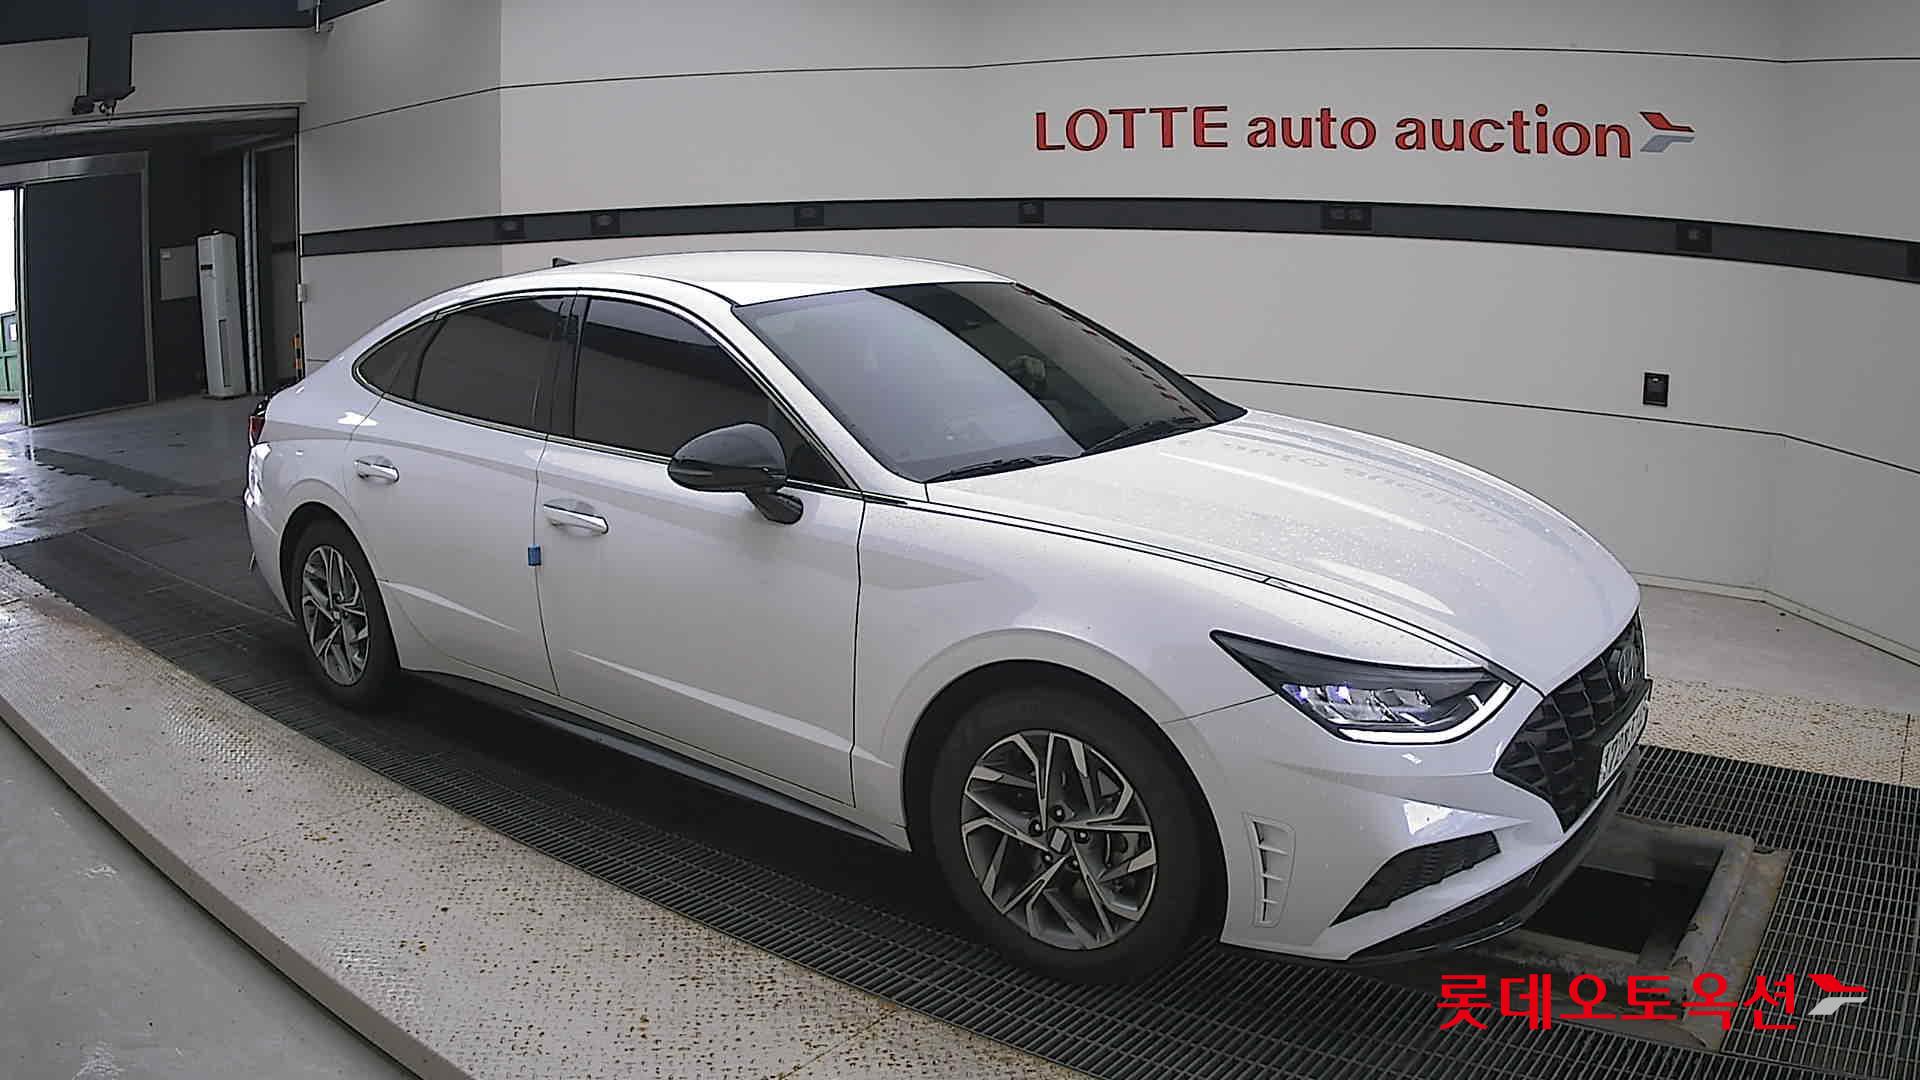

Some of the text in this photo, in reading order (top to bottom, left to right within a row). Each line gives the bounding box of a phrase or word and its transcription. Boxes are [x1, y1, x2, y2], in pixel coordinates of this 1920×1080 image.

[1035, 103, 1632, 158] LOTTE auto auction
